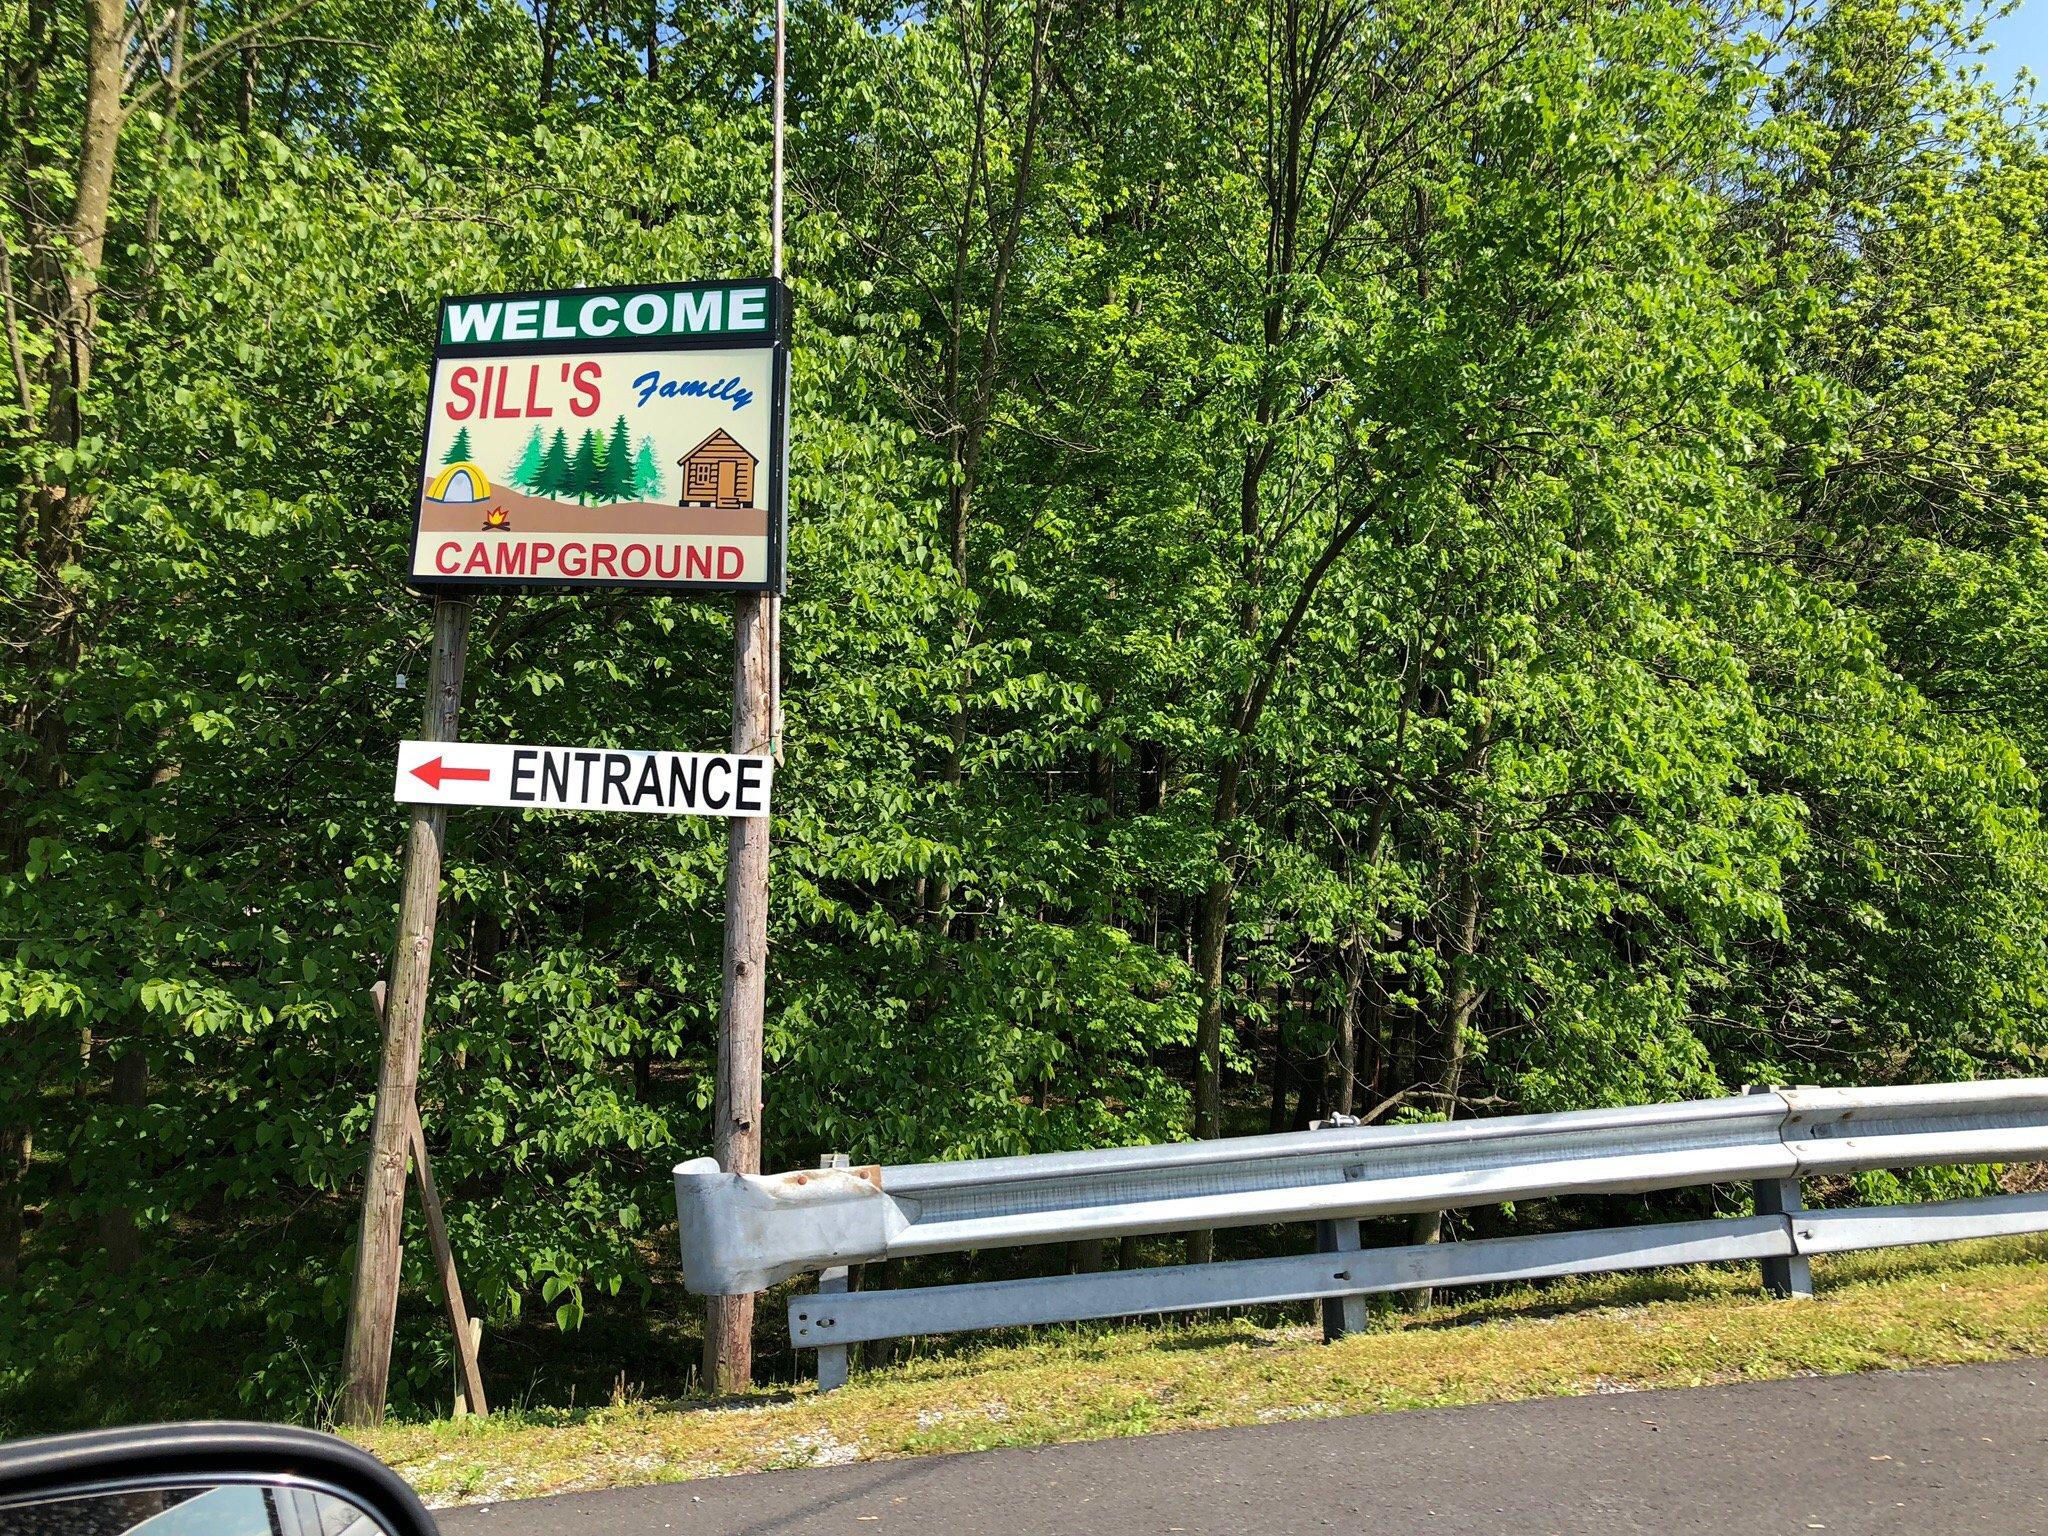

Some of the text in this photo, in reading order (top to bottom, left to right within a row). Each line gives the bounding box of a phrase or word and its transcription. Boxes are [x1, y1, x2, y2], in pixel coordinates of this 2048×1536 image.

[447, 288, 767, 342] WELCOME
[445, 361, 754, 421] SILL'S Family
[435, 541, 745, 580] CAMPGROUND
[509, 749, 763, 811] ENTRANCE
